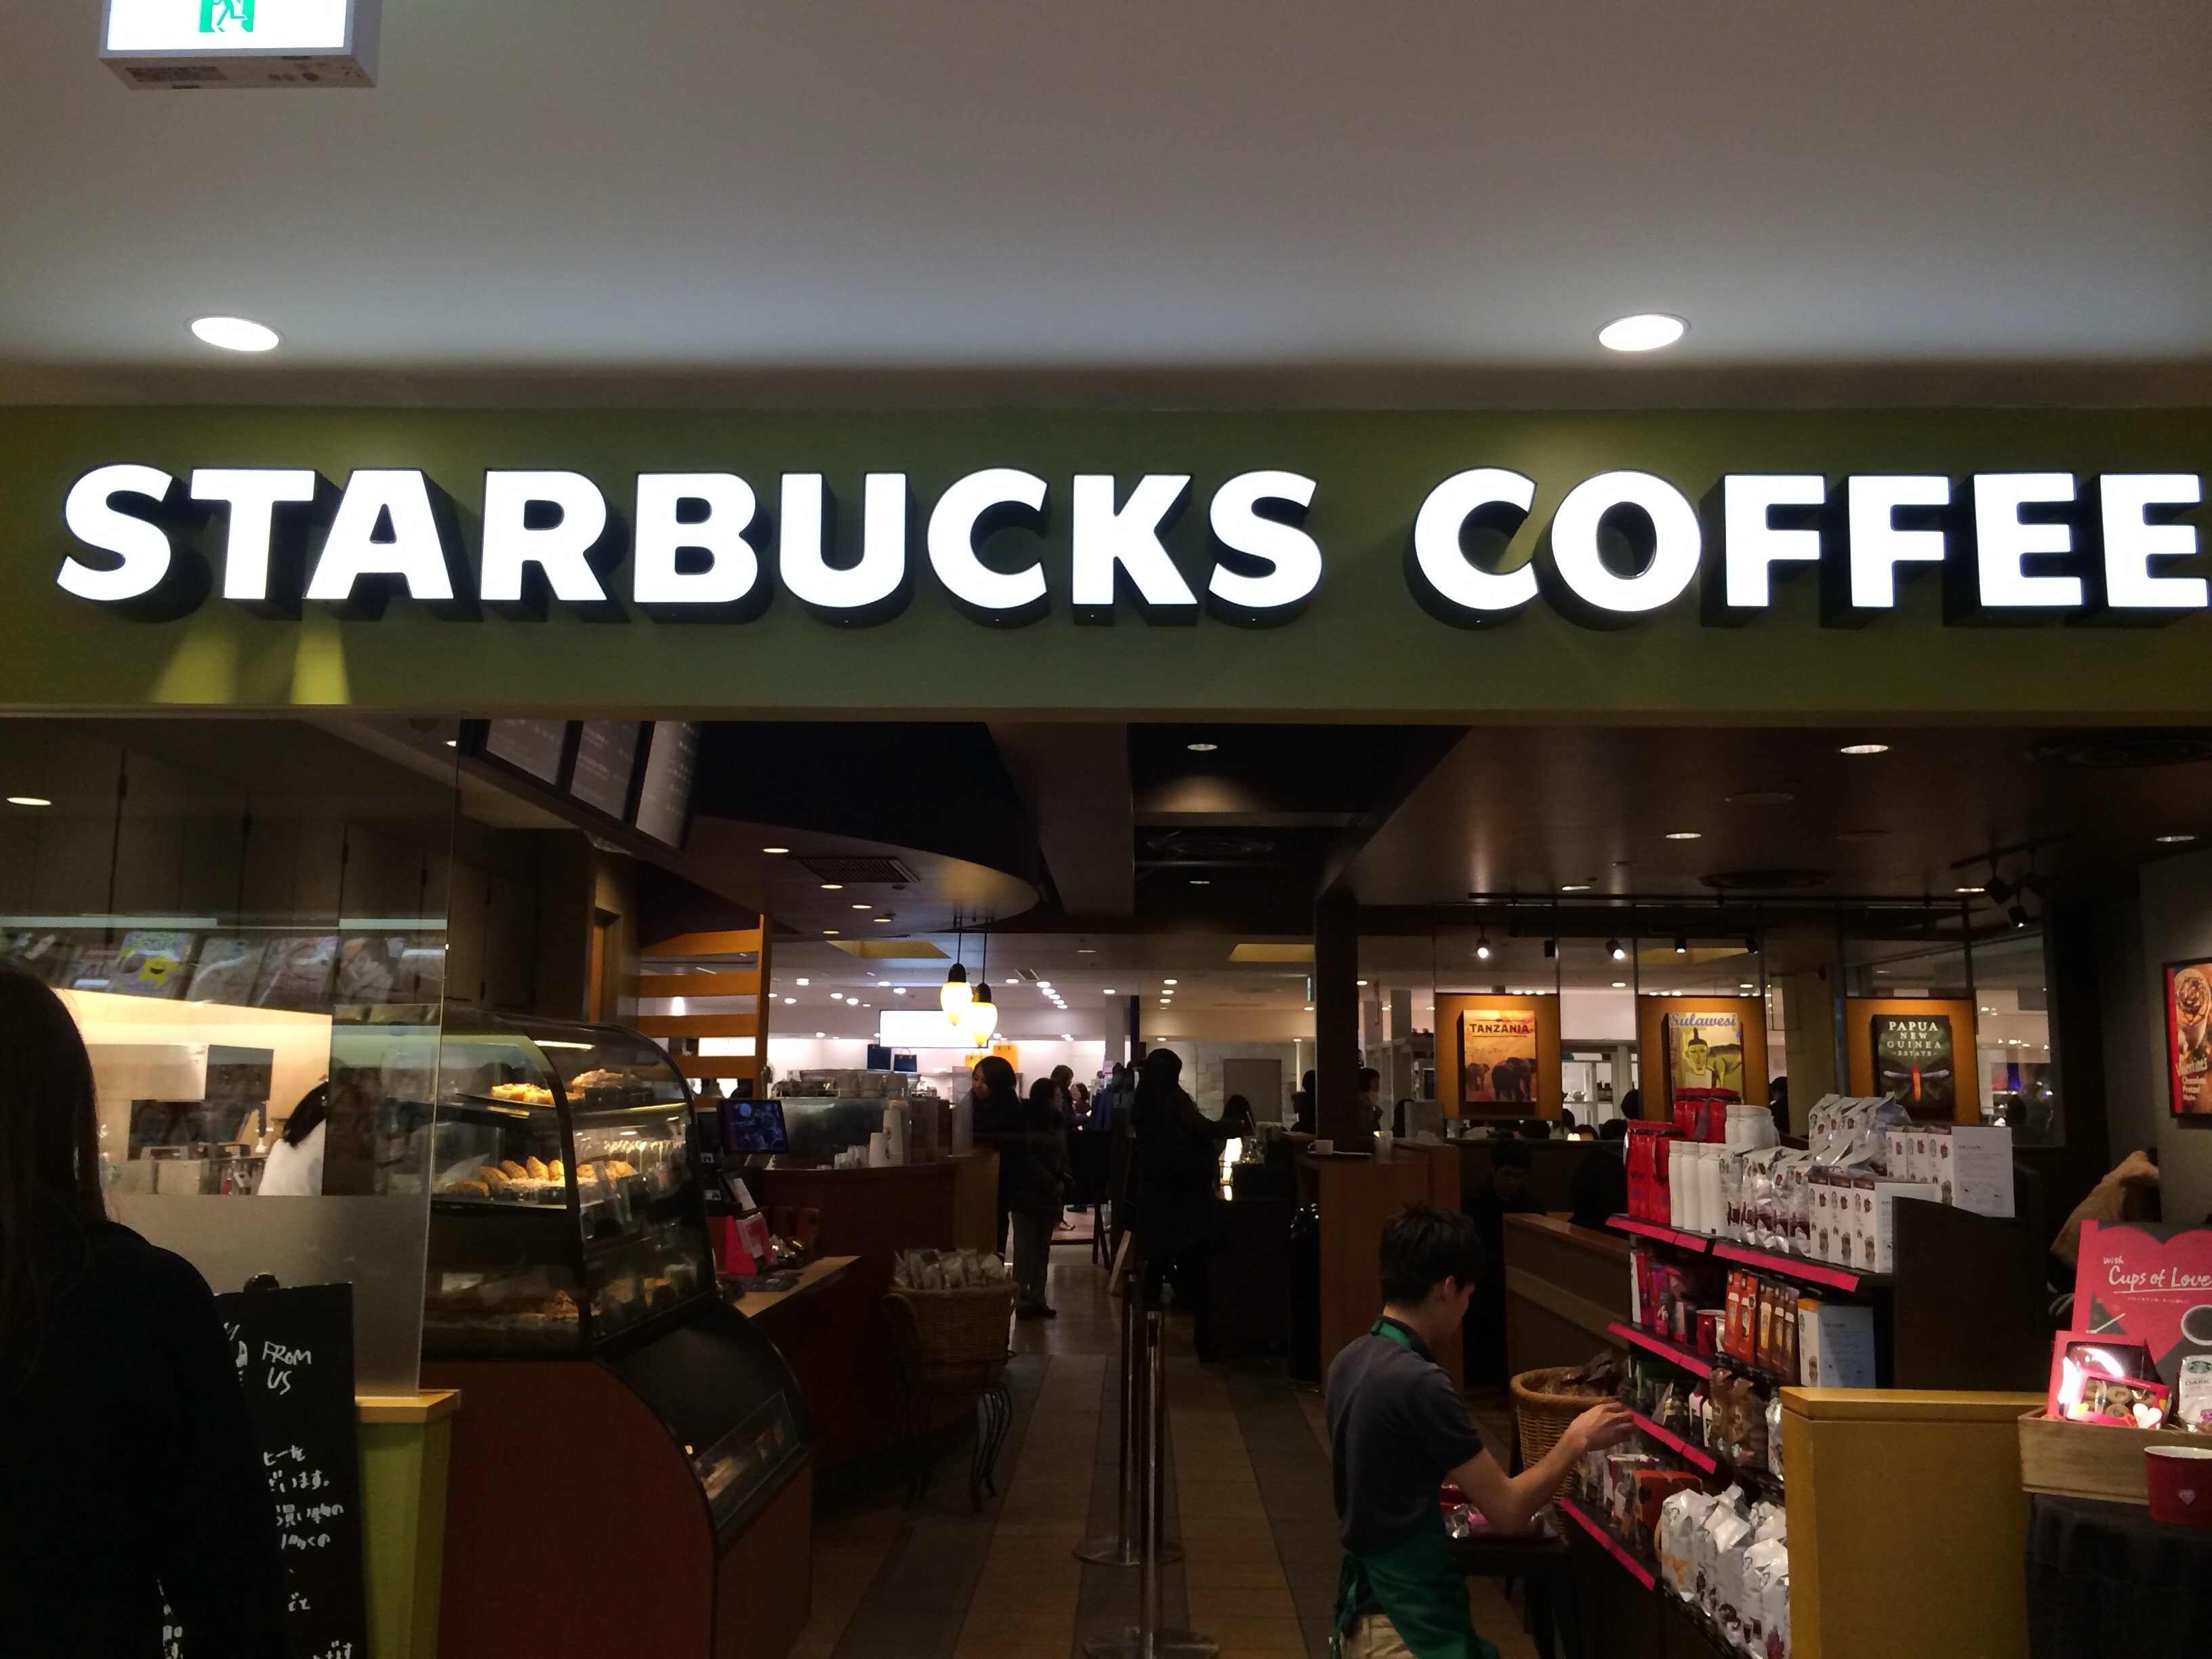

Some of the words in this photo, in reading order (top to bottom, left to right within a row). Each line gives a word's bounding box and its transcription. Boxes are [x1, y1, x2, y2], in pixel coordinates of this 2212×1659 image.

[56, 465, 1322, 609] STARBUCKS
[1414, 469, 2211, 612] COFFEE
[1670, 1012, 1736, 1027] Sulawesi
[1888, 1021, 1939, 1031] PAPUA
[1469, 1023, 1530, 1033] TANZANIA
[1900, 1031, 1928, 1040] NEW
[1887, 1040, 1942, 1049] GUINEA
[2108, 1265, 2146, 1292] Cups
[2150, 1269, 2166, 1288] of
[2171, 1267, 2212, 1288] Love
[262, 1340, 312, 1366] FROM
[266, 1367, 293, 1395] US
